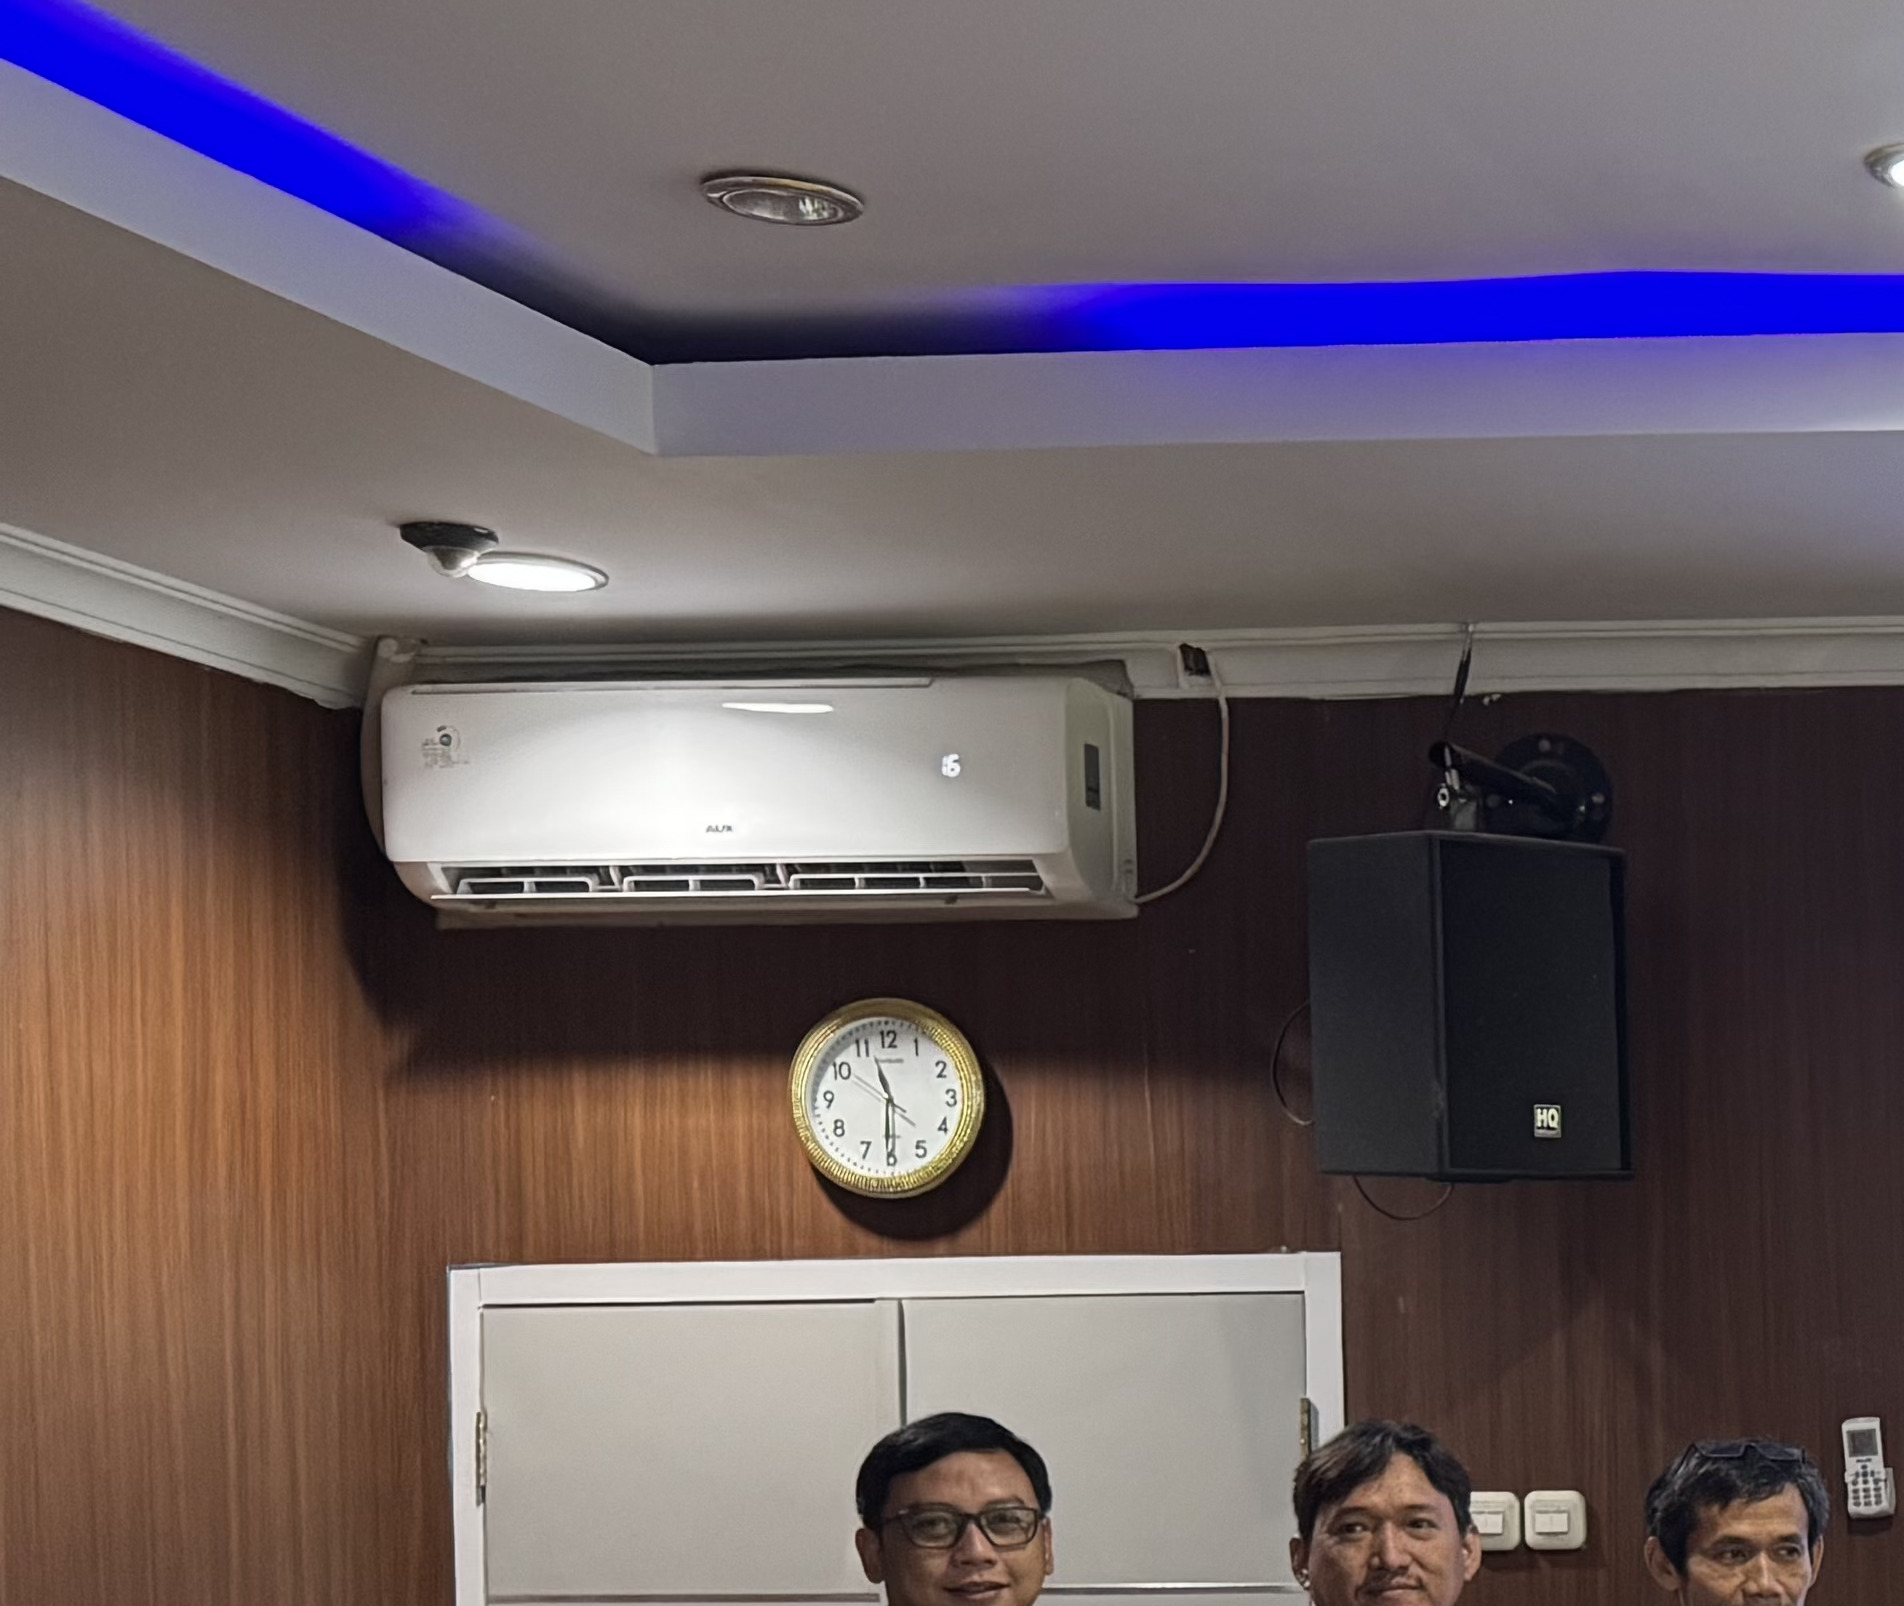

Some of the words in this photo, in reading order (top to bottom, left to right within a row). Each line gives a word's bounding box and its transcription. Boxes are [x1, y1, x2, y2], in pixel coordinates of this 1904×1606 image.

[855, 1039, 869, 1057] 11
[880, 1030, 897, 1048] 12
[913, 1039, 919, 1056] 1
[833, 1062, 851, 1080] 10
[935, 1061, 947, 1078] 2
[823, 1090, 834, 1109] 9
[945, 1089, 957, 1107] 3
[937, 1117, 948, 1133] 4
[1536, 1108, 1559, 1128] HQ
[833, 1119, 845, 1137] 8
[860, 1141, 871, 1159] 7
[915, 1140, 927, 1158] 5
